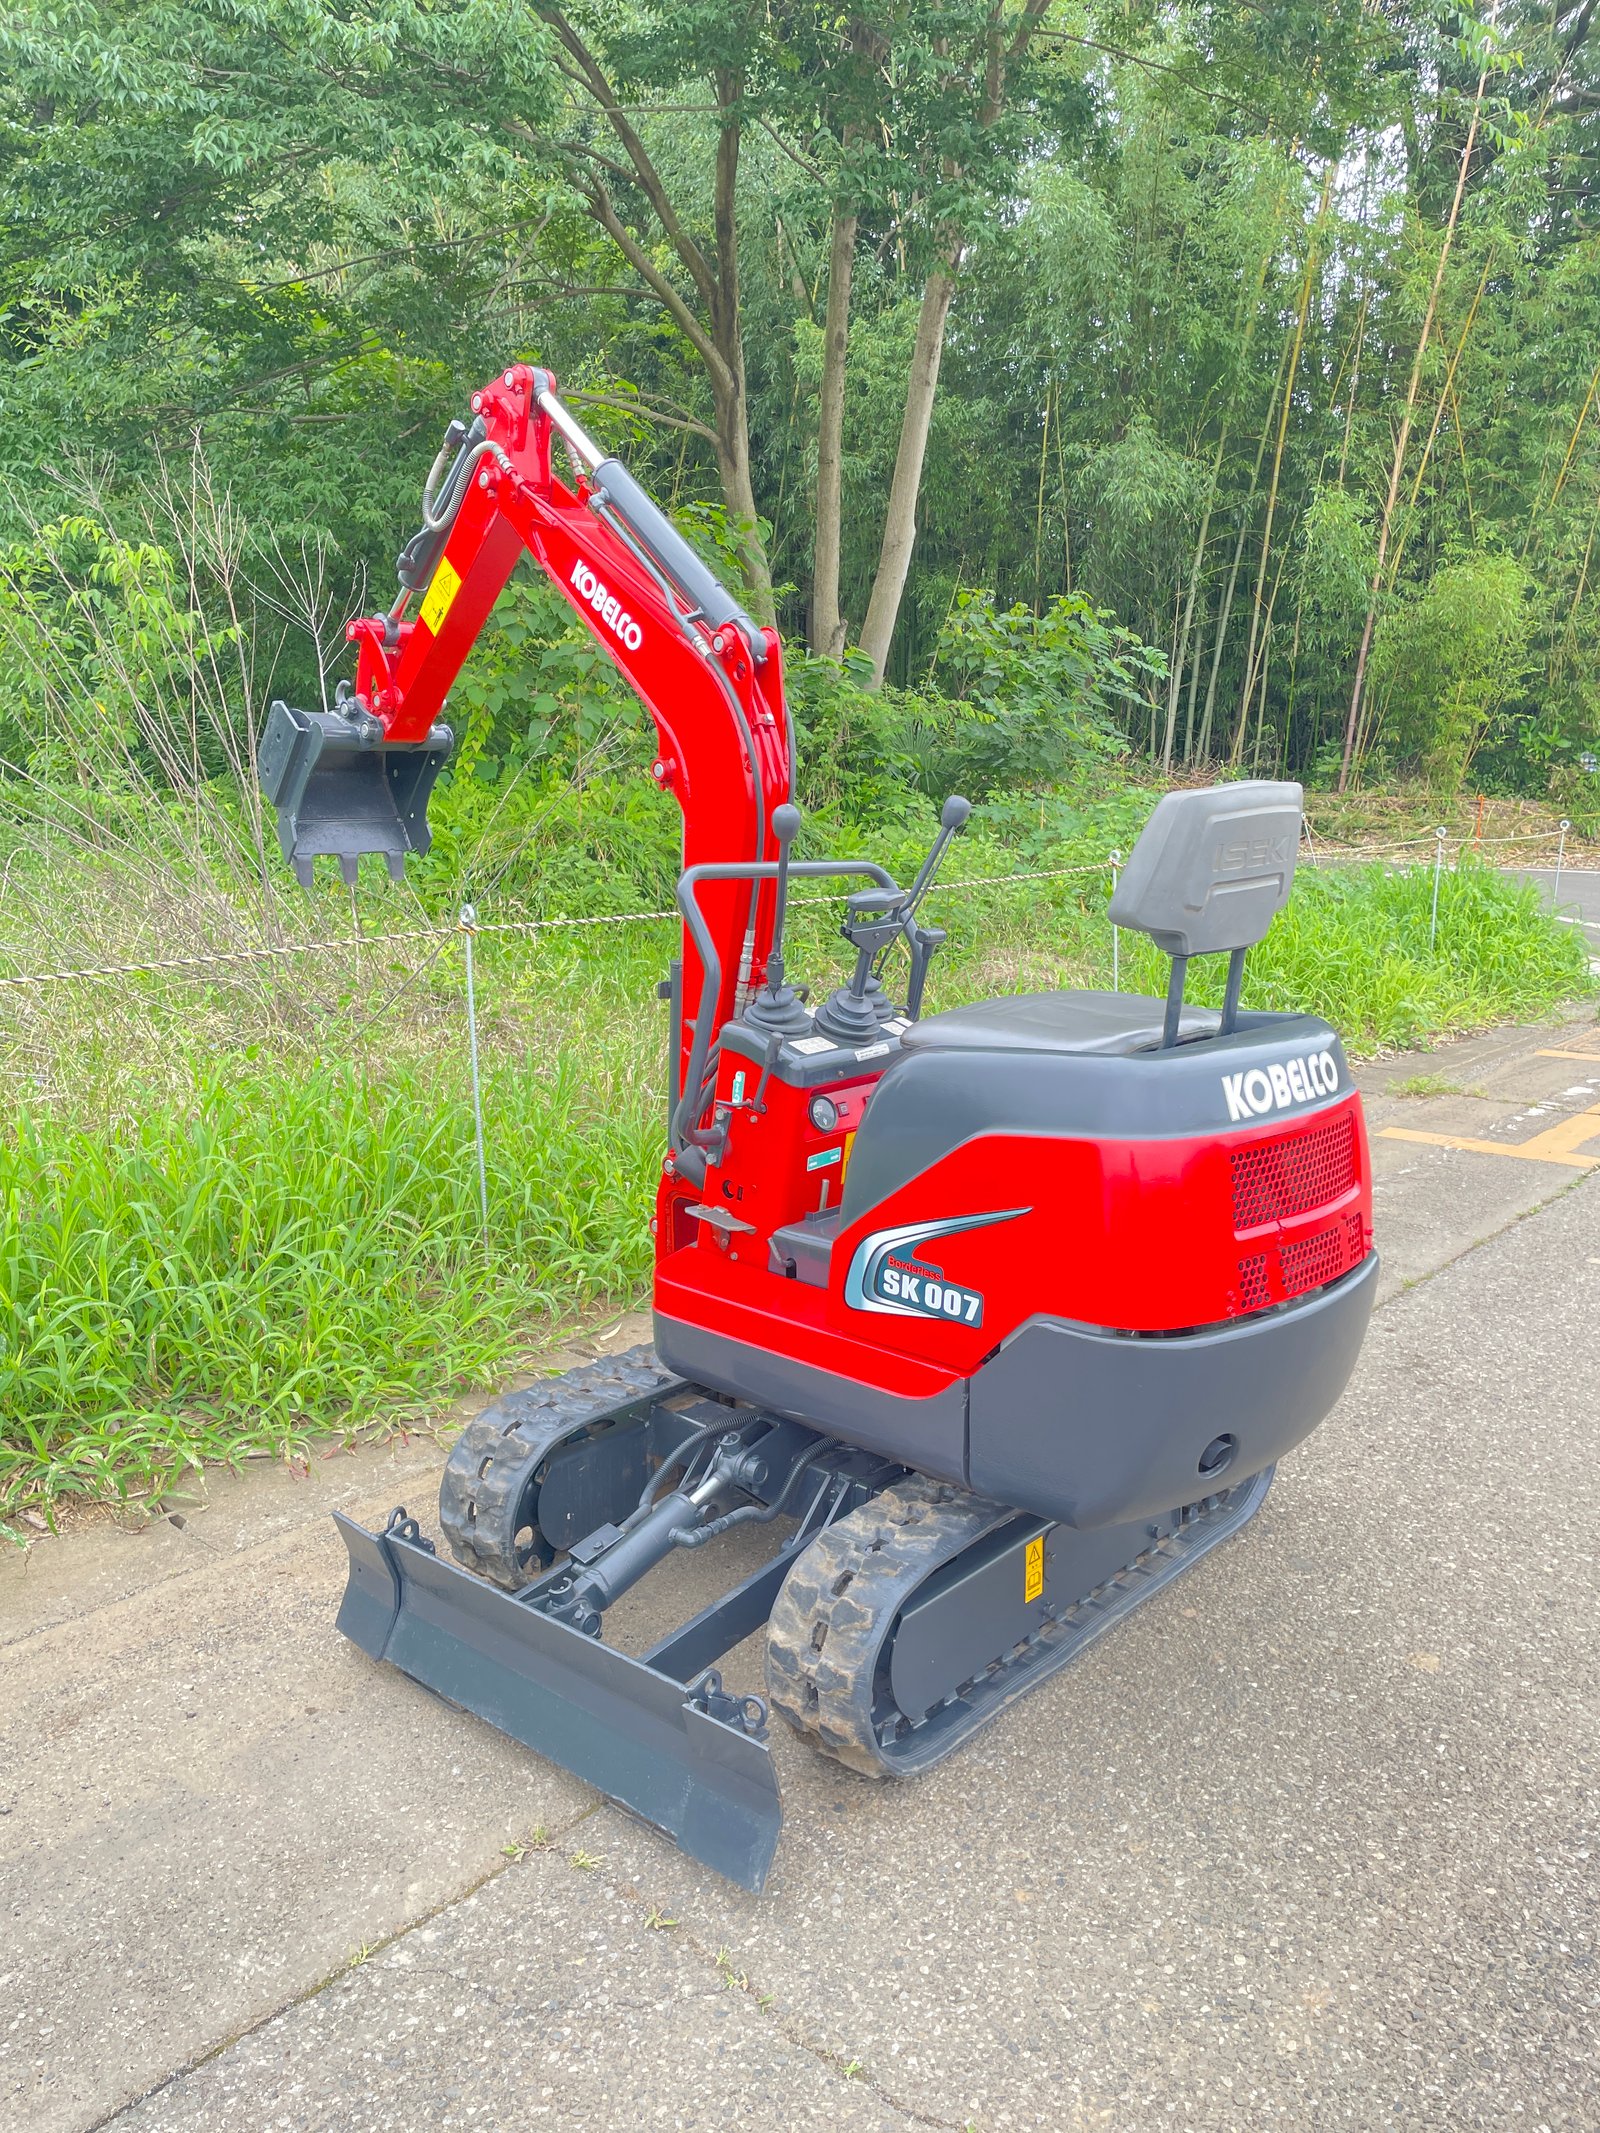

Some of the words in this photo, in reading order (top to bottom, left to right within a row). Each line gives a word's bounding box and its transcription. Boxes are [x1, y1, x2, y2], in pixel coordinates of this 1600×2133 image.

[570, 559, 643, 651] KOBELCO
[1212, 835, 1293, 872] ISEKI
[1221, 1051, 1339, 1122] KOBELCO
[883, 1268, 920, 1304] SK
[924, 1282, 980, 1322] 007
[887, 1255, 941, 1281] Borderless
